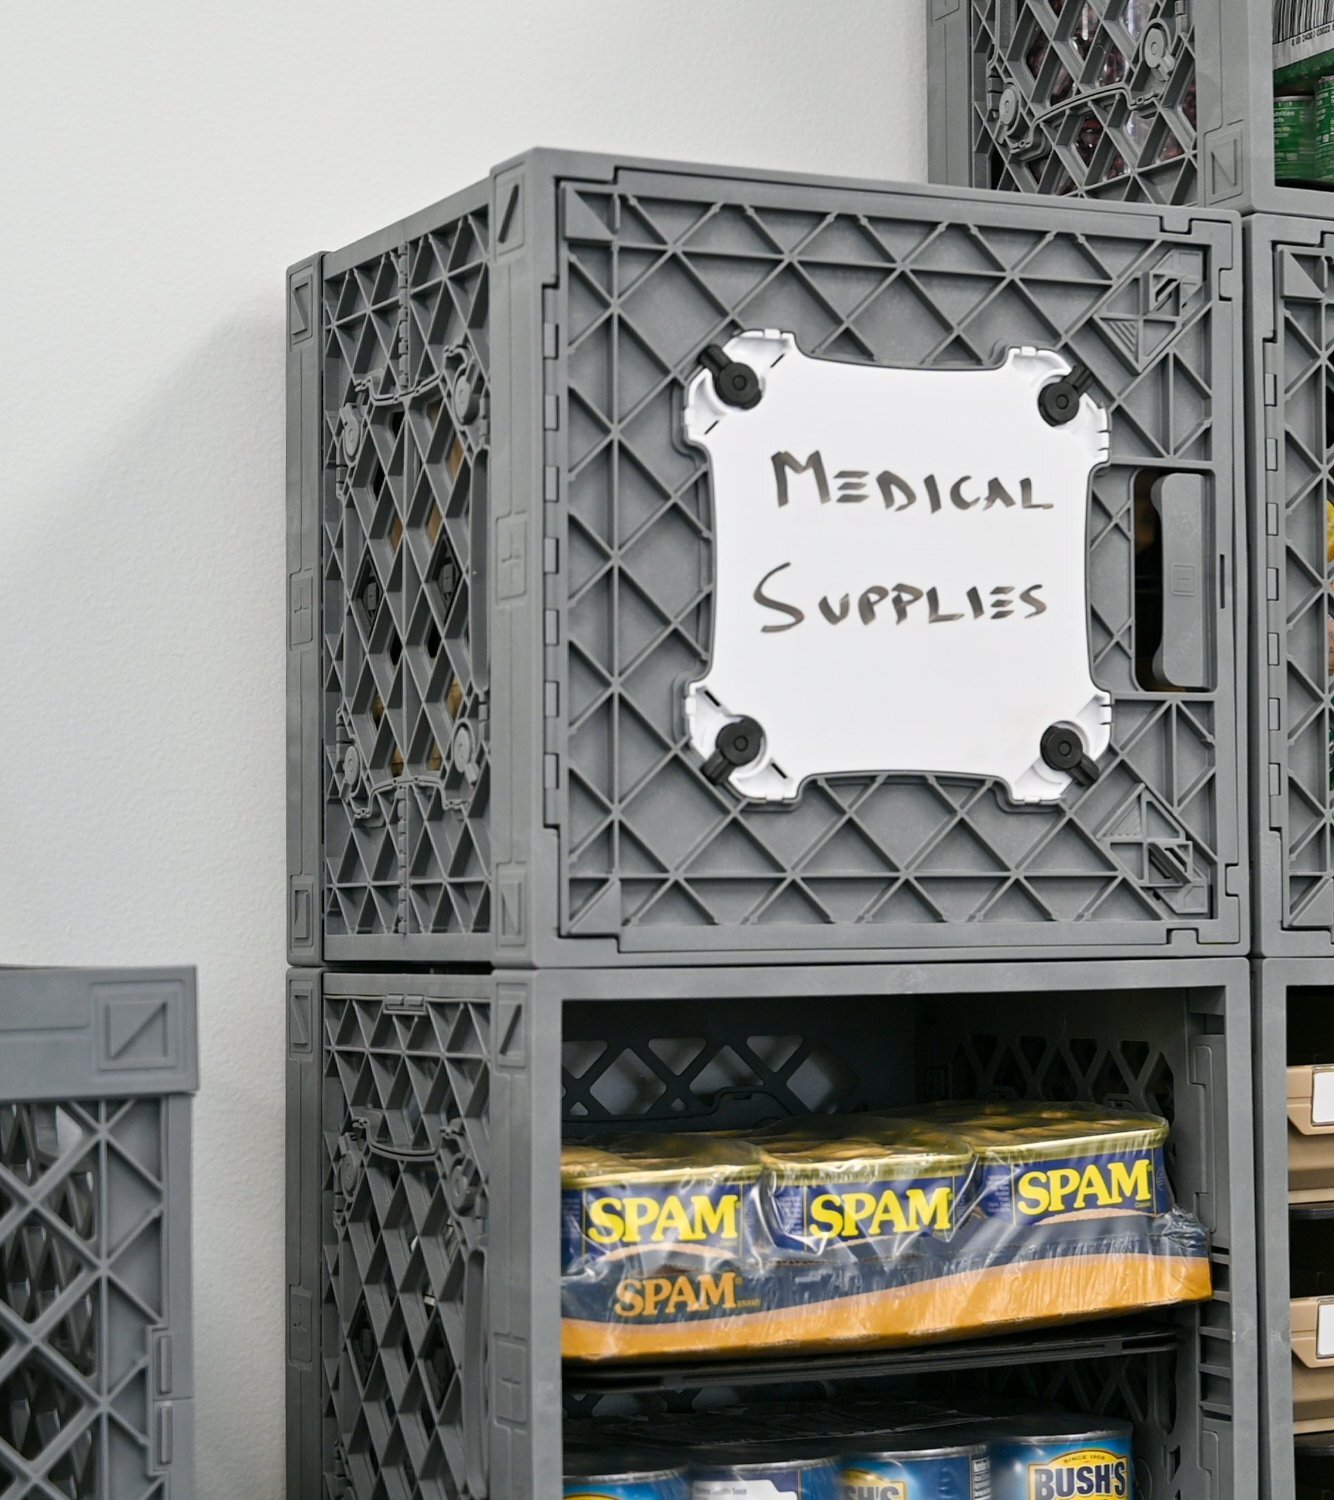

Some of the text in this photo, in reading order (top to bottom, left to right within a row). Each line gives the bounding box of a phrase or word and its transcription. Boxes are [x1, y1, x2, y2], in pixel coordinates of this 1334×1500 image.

[770, 450, 1054, 514] MEDICAL
[753, 561, 1048, 634] SUPPLIES
[810, 1187, 951, 1240] SPAM
[1017, 1159, 1152, 1215] SPAM
[587, 1194, 738, 1244] SPAM
[614, 1271, 738, 1318] SPAM
[1035, 1460, 1126, 1500] BUSH'S
